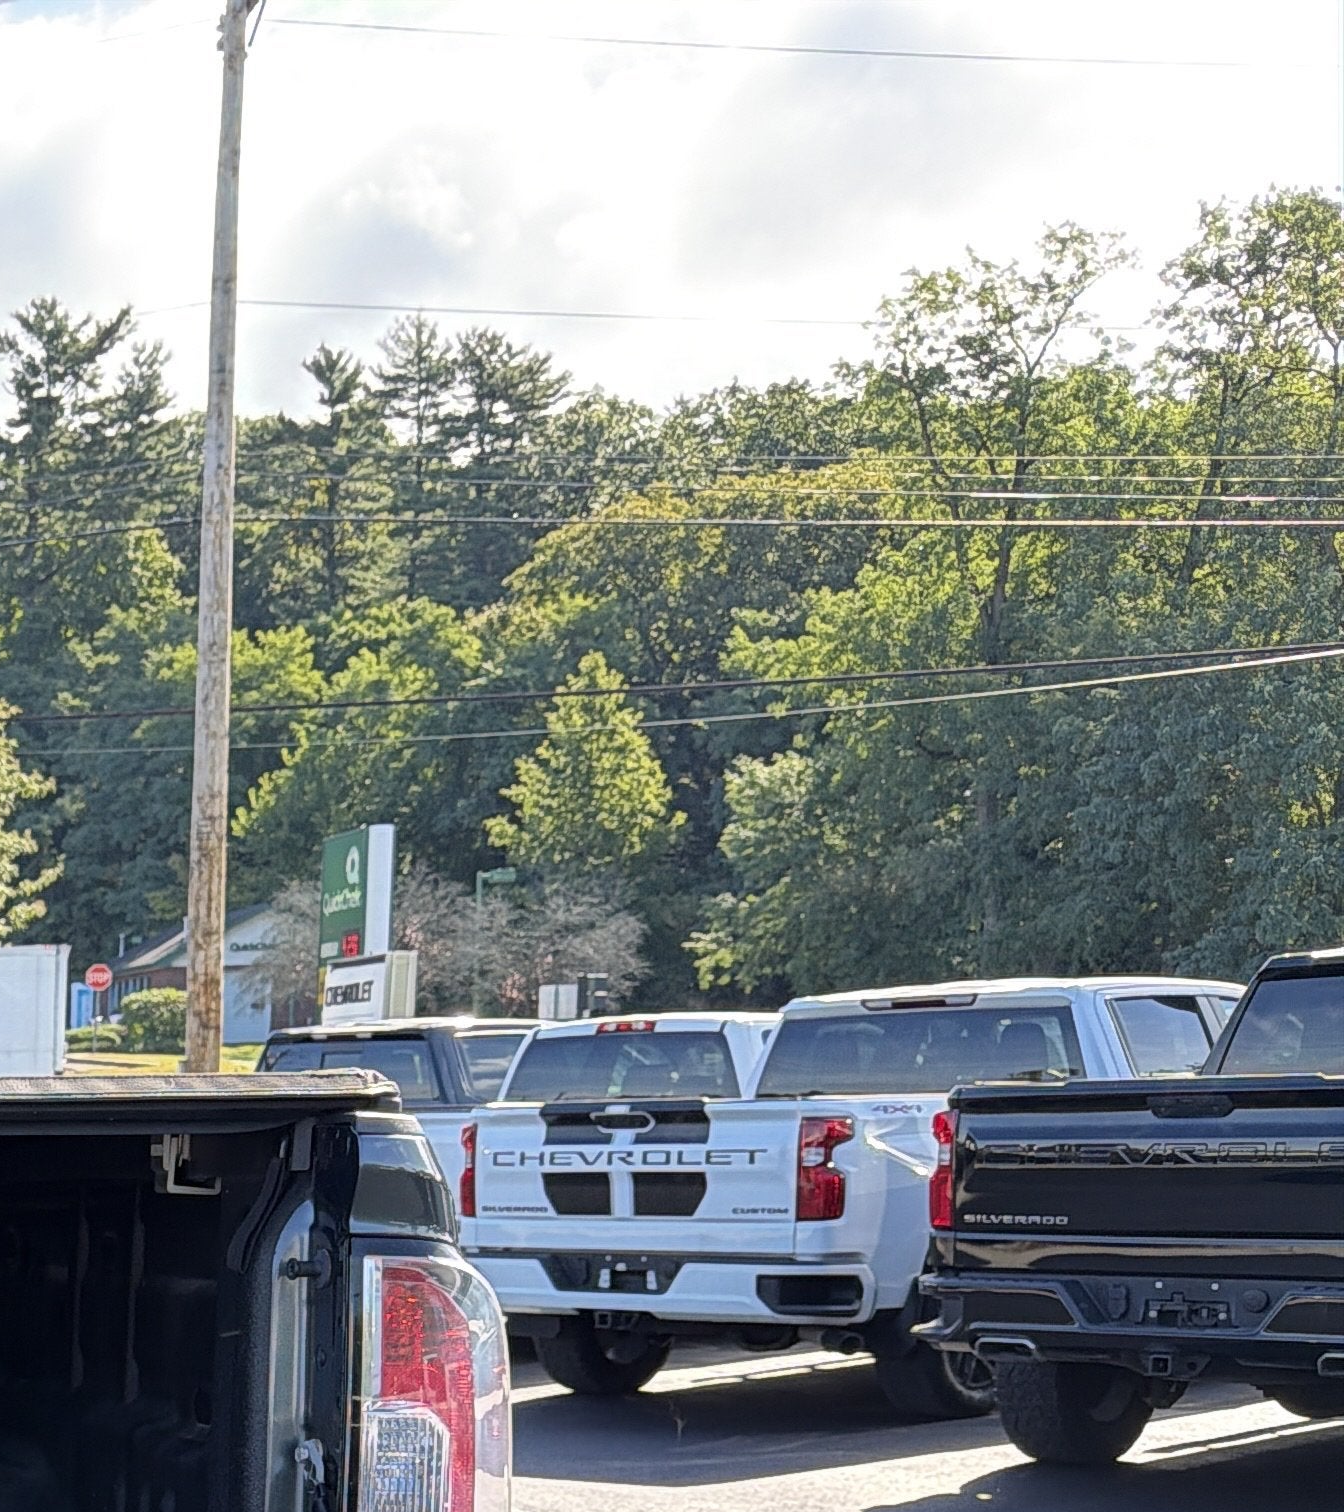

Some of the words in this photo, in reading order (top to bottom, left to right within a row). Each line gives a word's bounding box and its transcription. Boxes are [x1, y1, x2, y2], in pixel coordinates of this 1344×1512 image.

[87, 971, 111, 984] STOP
[492, 1148, 768, 1167] CHEVROLET
[732, 1207, 789, 1215] CUSTOM
[963, 1213, 1069, 1225] SILVERADO
